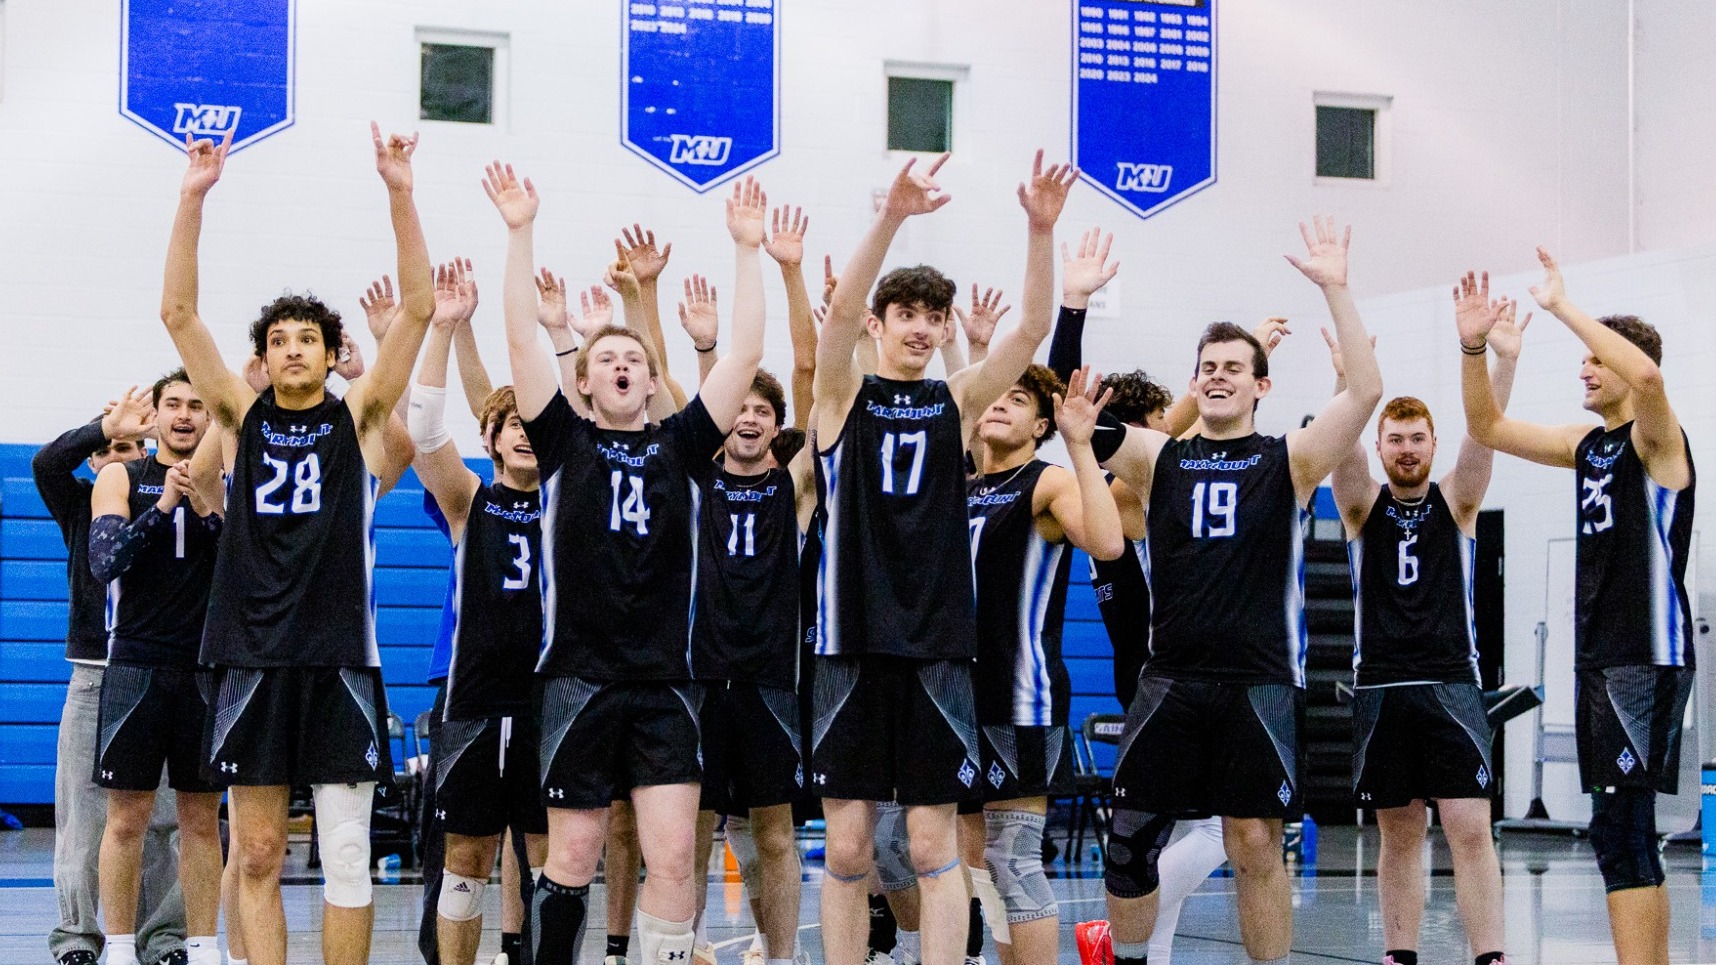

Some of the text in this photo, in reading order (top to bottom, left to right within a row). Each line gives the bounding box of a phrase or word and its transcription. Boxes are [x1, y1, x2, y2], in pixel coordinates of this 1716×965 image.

[255, 451, 322, 514] 28
[880, 430, 927, 495] 17
[610, 470, 651, 535] 14
[1191, 482, 1238, 538] 19
[1582, 473, 1614, 535] 25
[173, 506, 185, 558] 1
[727, 513, 756, 557] 11
[1397, 534, 1419, 586] 6
[503, 533, 532, 589] 3
